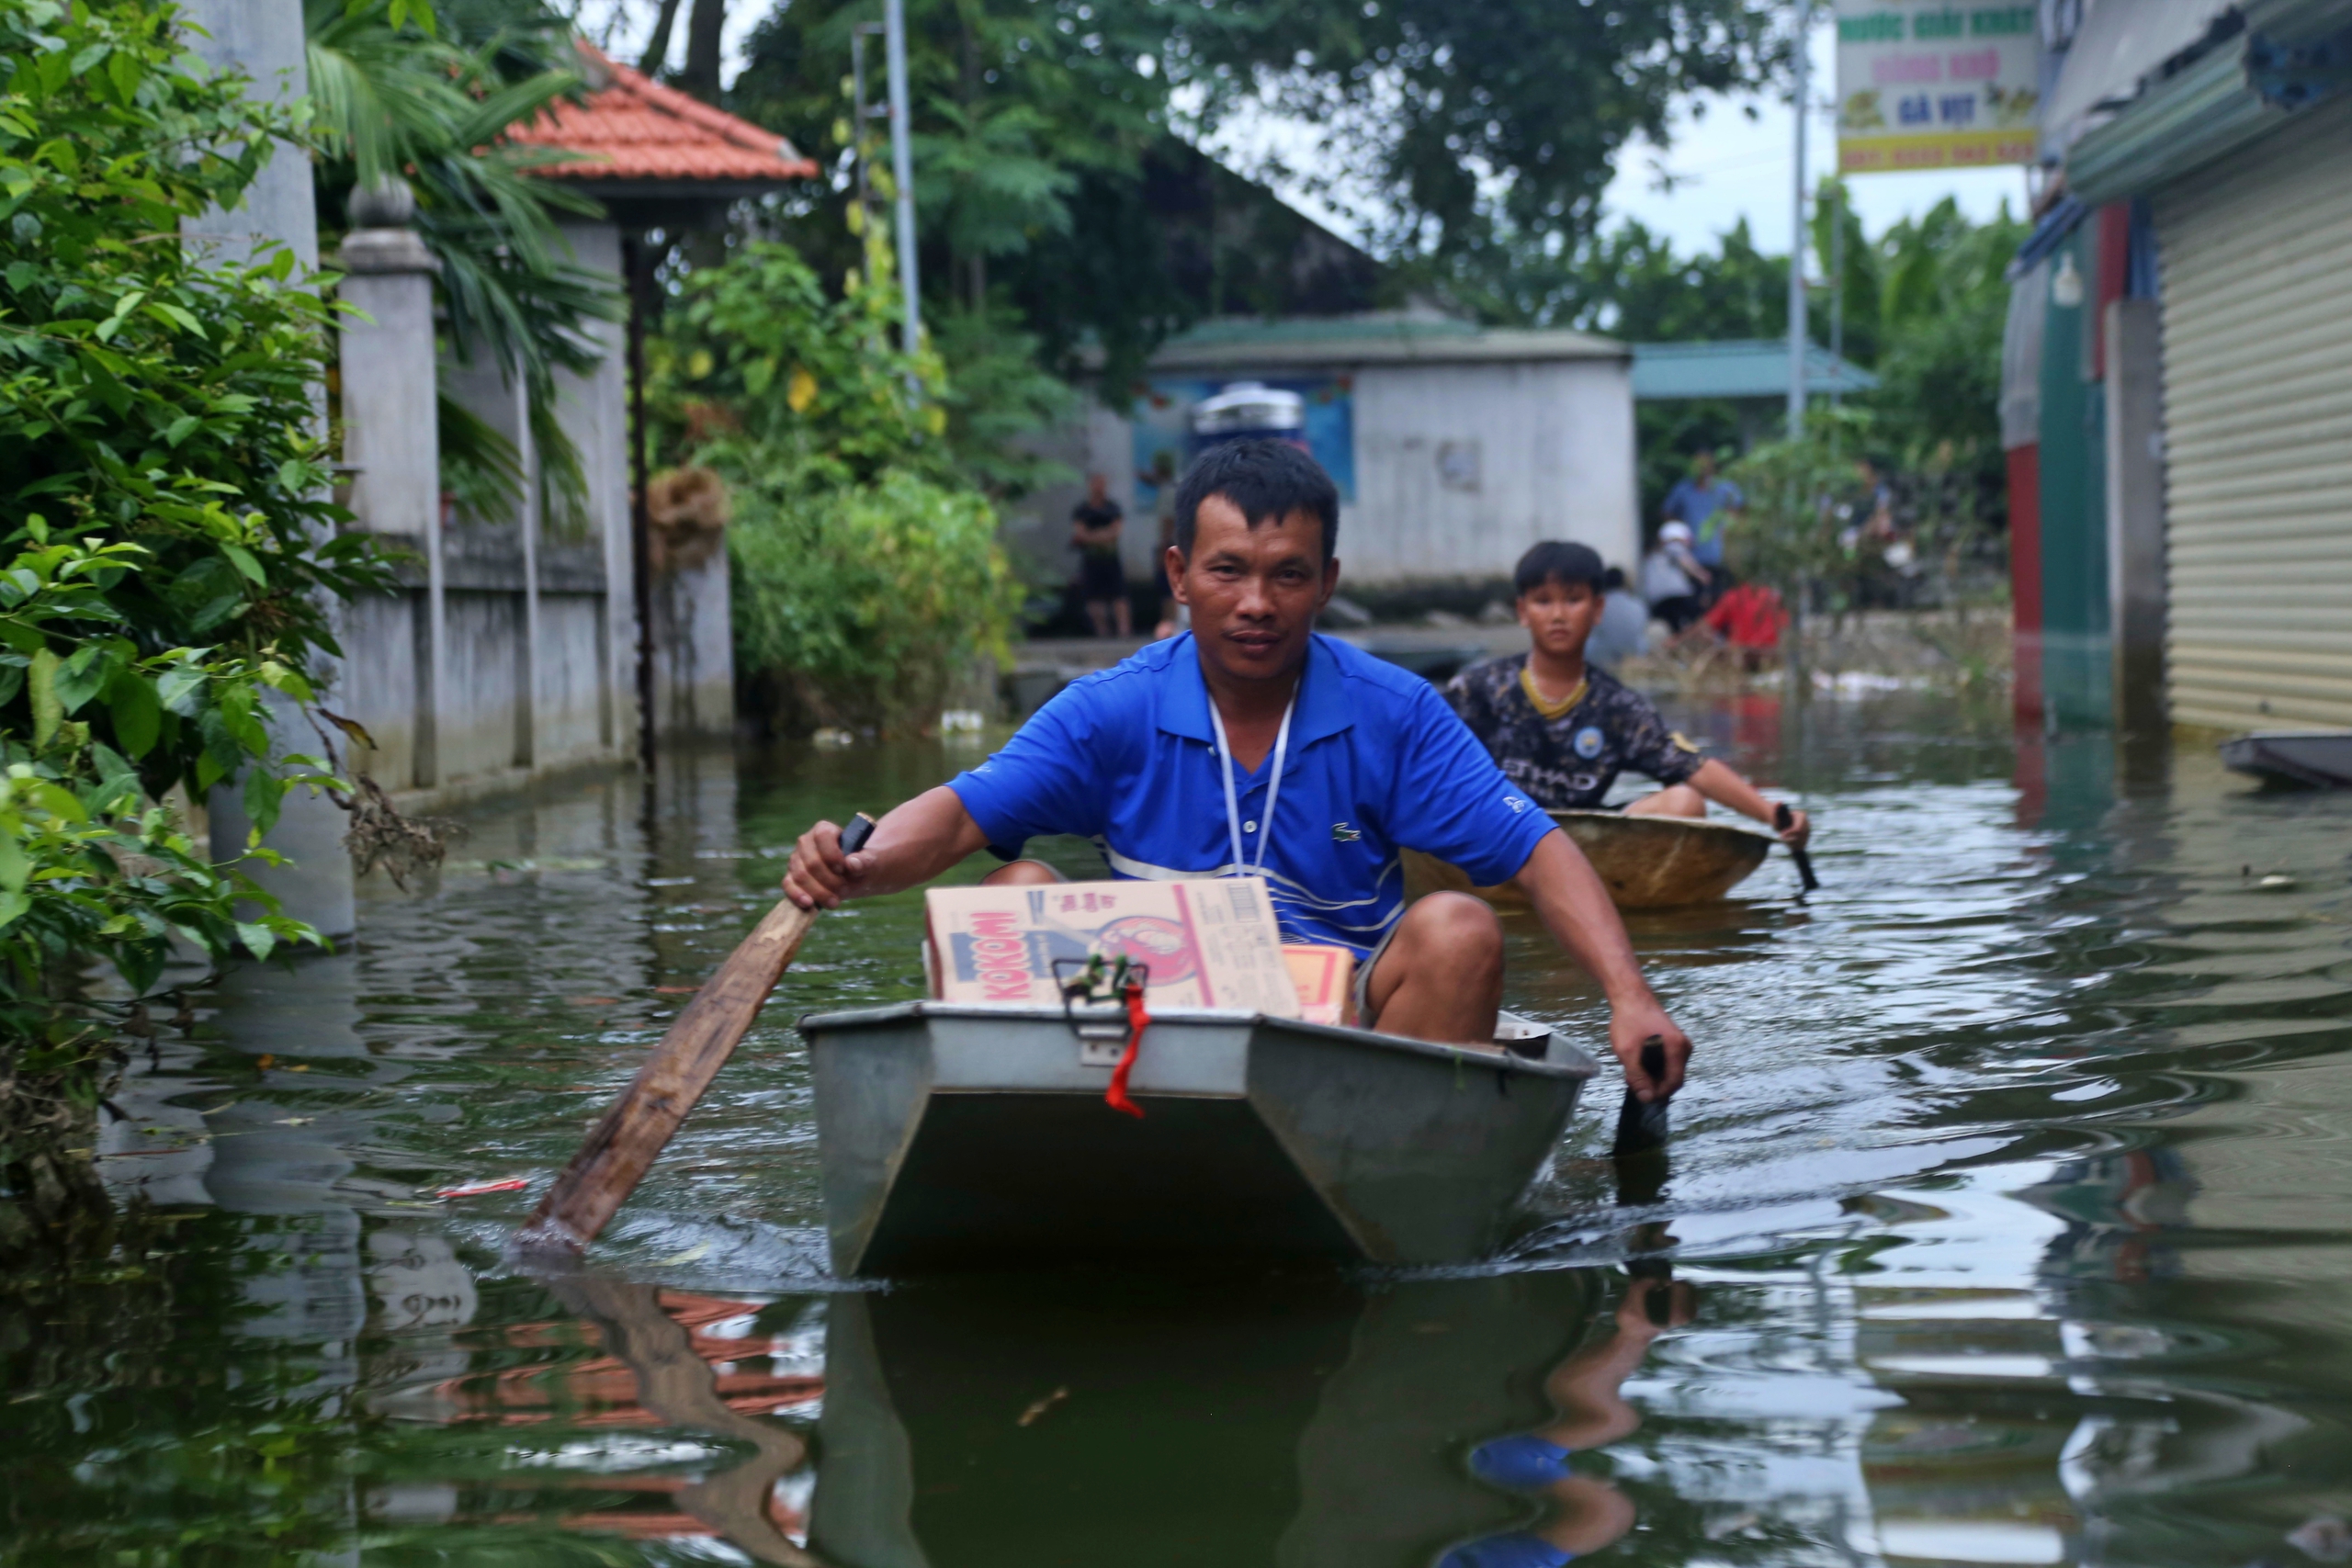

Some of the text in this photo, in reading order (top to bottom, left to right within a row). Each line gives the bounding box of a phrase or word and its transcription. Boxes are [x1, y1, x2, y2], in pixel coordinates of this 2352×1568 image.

[1898, 93, 1976, 130] GÀ VỊT
[970, 910, 1034, 1001] KOKOMI
